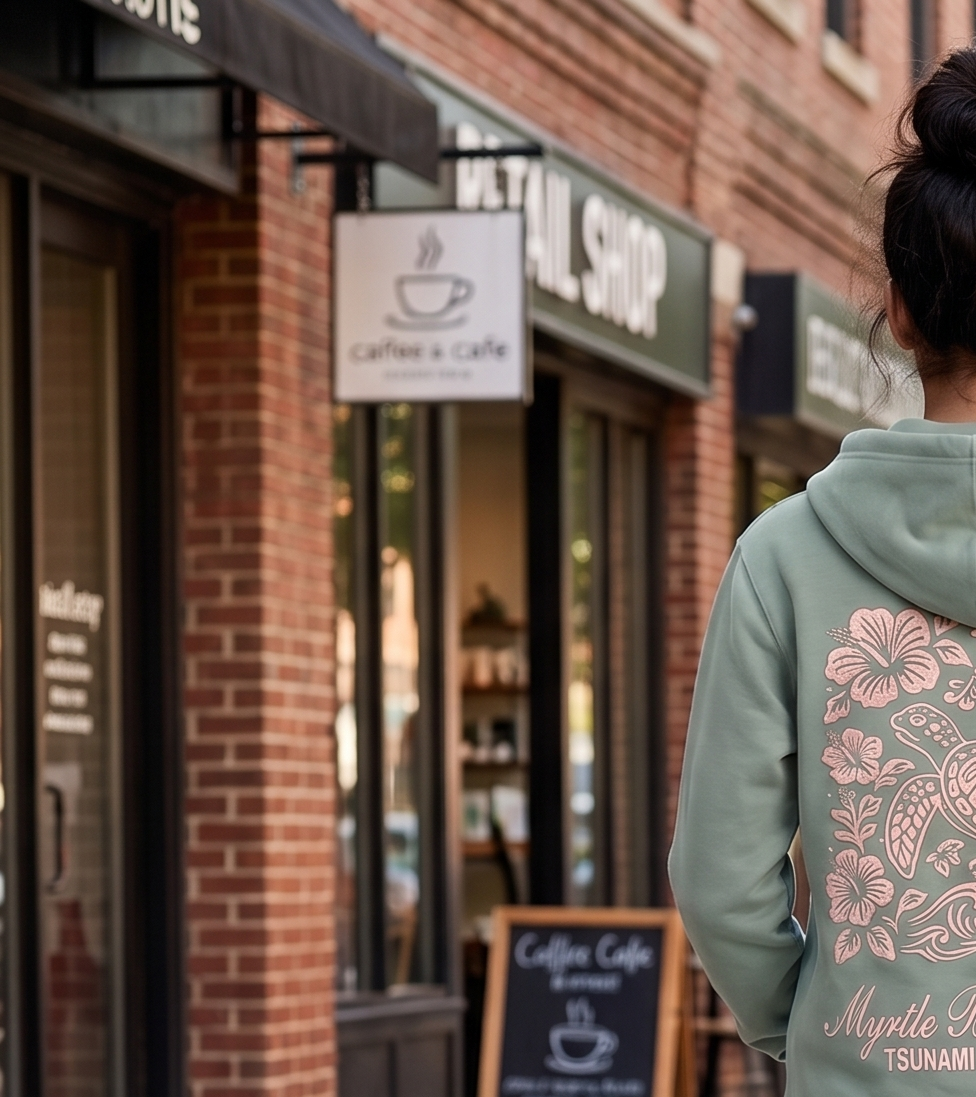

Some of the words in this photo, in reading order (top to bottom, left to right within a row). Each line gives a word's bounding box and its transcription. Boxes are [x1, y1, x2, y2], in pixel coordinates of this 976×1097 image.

[456, 122, 580, 303] RETAIL
[581, 193, 668, 340] SHOP
[824, 984, 938, 1060] Myrtle
[884, 1046, 975, 1071] TSUNAMI
